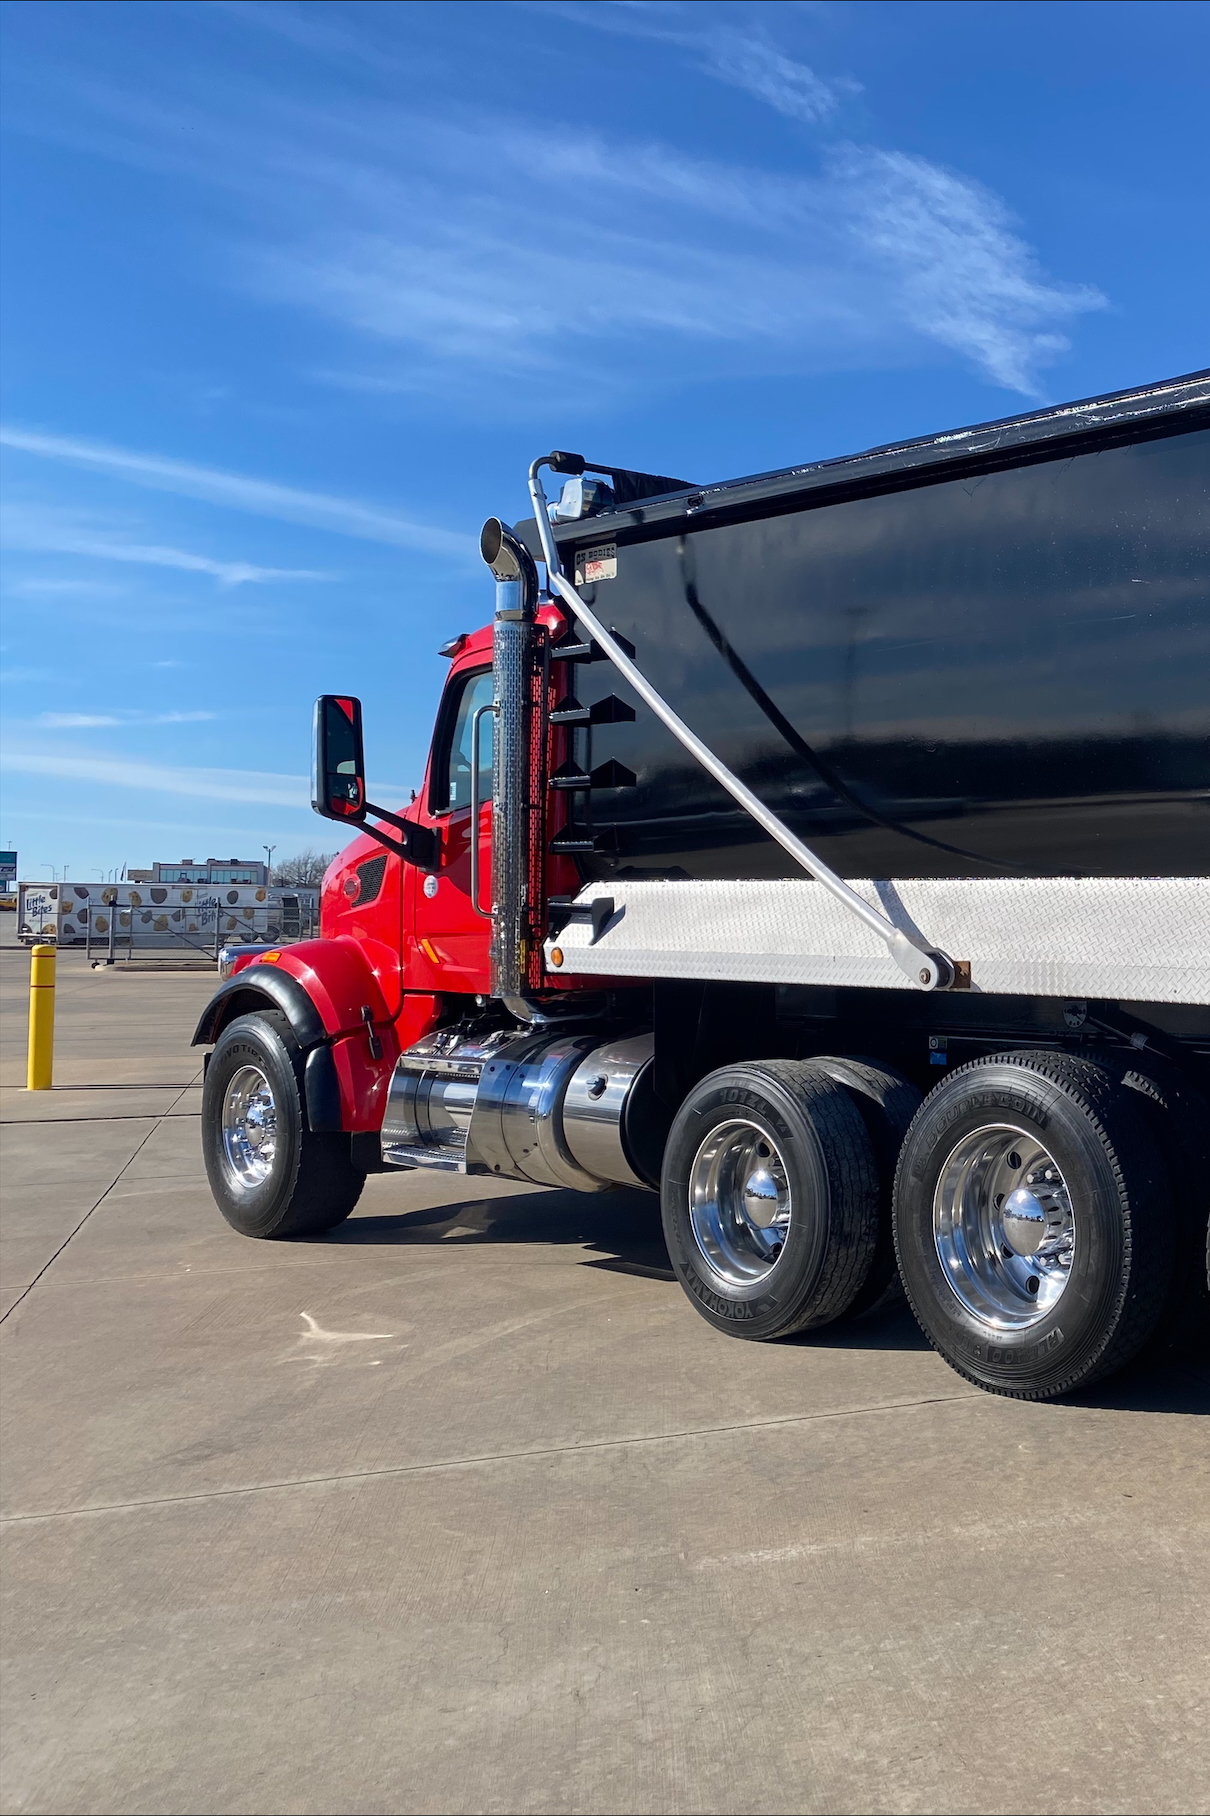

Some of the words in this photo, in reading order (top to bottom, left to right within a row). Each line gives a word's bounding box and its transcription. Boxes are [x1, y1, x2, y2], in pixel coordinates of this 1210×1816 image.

[26, 895, 46, 911] Little
[32, 904, 52, 918] Bites
[925, 1092, 995, 1149] DOUBLE
[998, 1093, 1048, 1125] COIN
[686, 1264, 754, 1319] YOKOHAMA
